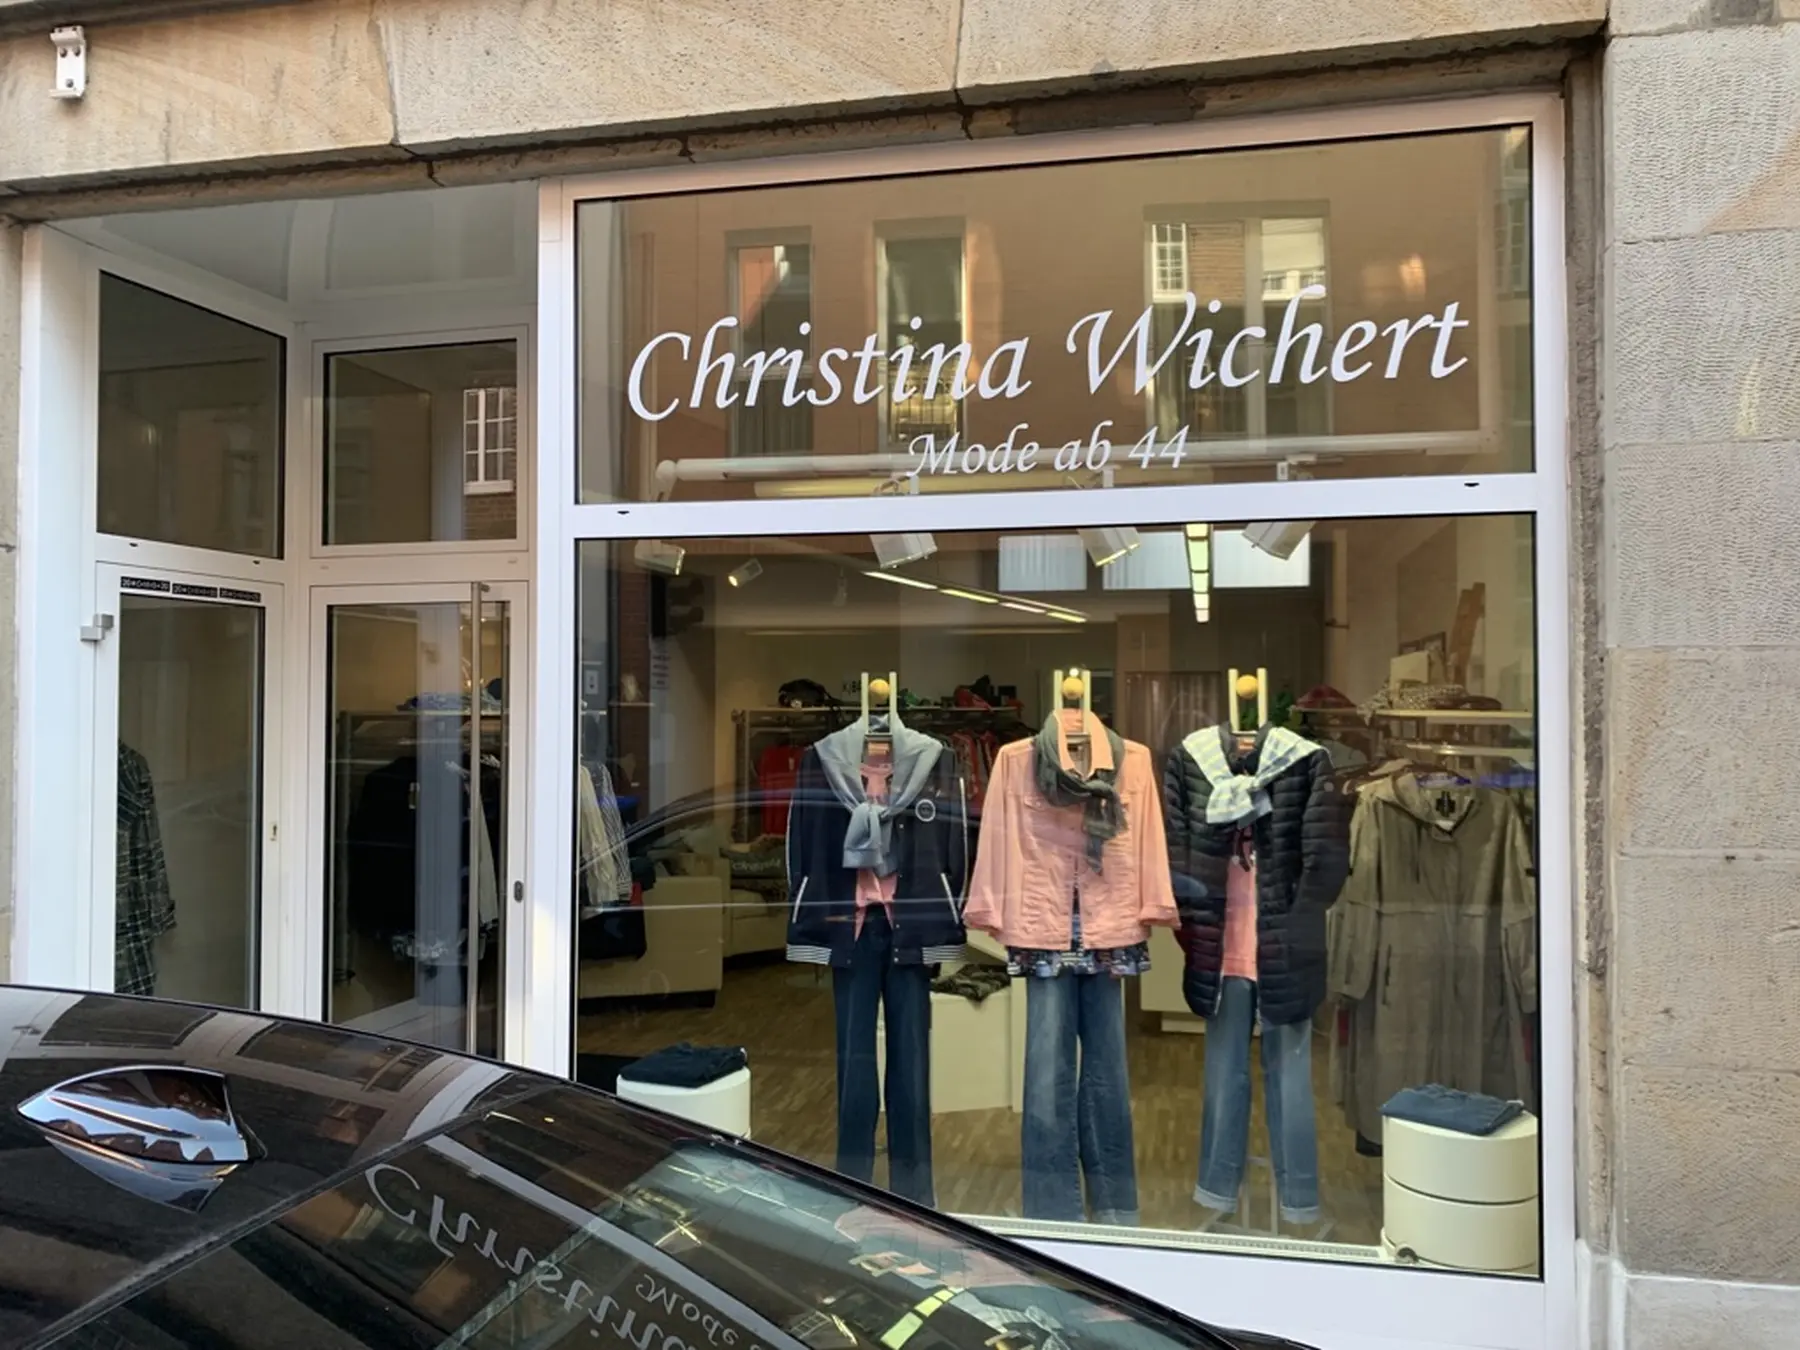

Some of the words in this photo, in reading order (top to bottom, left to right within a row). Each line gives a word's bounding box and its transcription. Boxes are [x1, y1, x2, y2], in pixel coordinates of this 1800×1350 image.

[627, 316, 1031, 421] Christina
[1066, 285, 1469, 394] Wichert
[908, 425, 1039, 477] Mode
[1053, 420, 1113, 470] ab
[1128, 425, 1190, 469] 44
